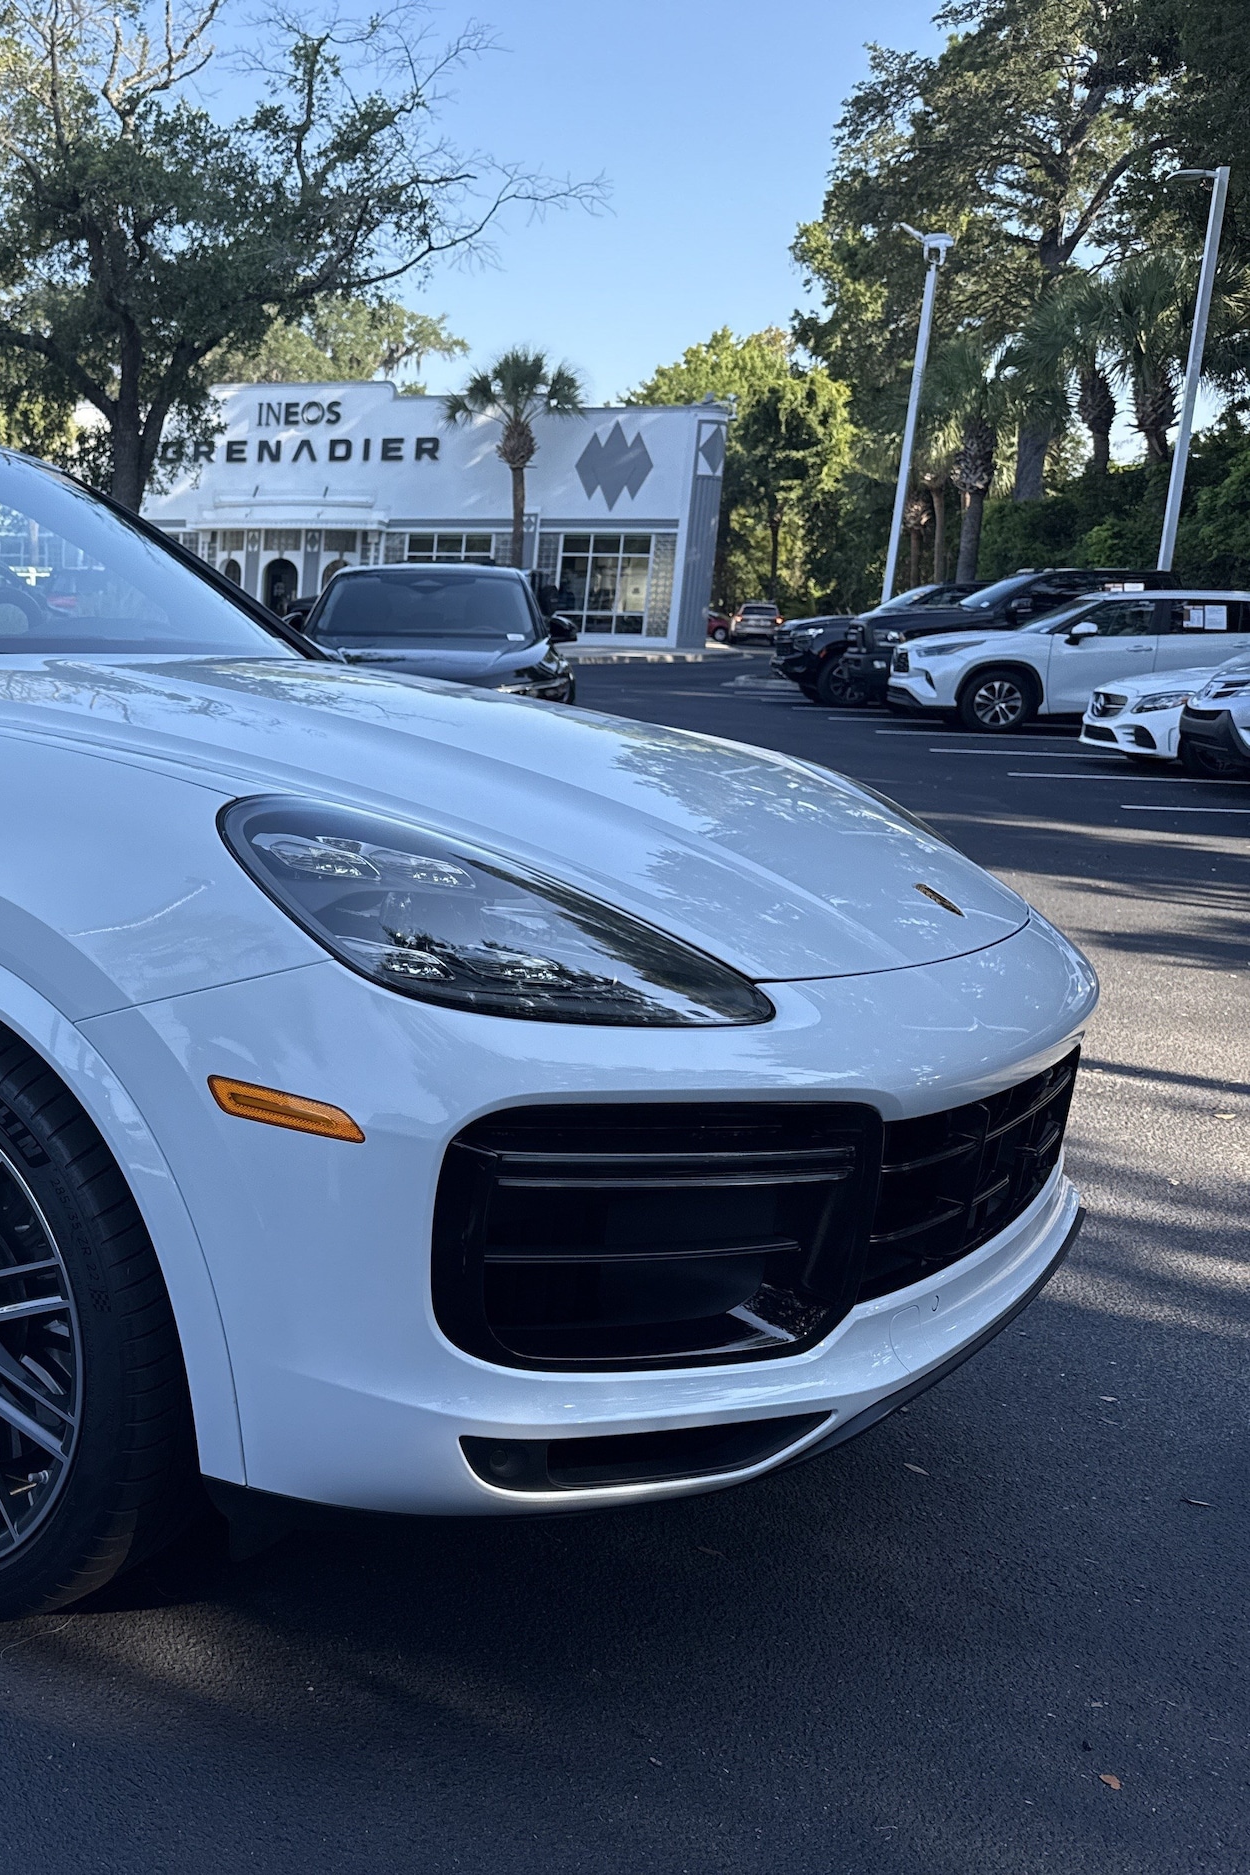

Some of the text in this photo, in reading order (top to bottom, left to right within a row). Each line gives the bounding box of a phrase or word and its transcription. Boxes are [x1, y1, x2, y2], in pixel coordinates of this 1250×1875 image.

[257, 401, 342, 426] INEOS
[160, 437, 440, 463] GRENADIER
[49, 1177, 83, 1233] 285/35
[75, 1236, 92, 1256] ZR
[85, 1262, 100, 1281] 22
